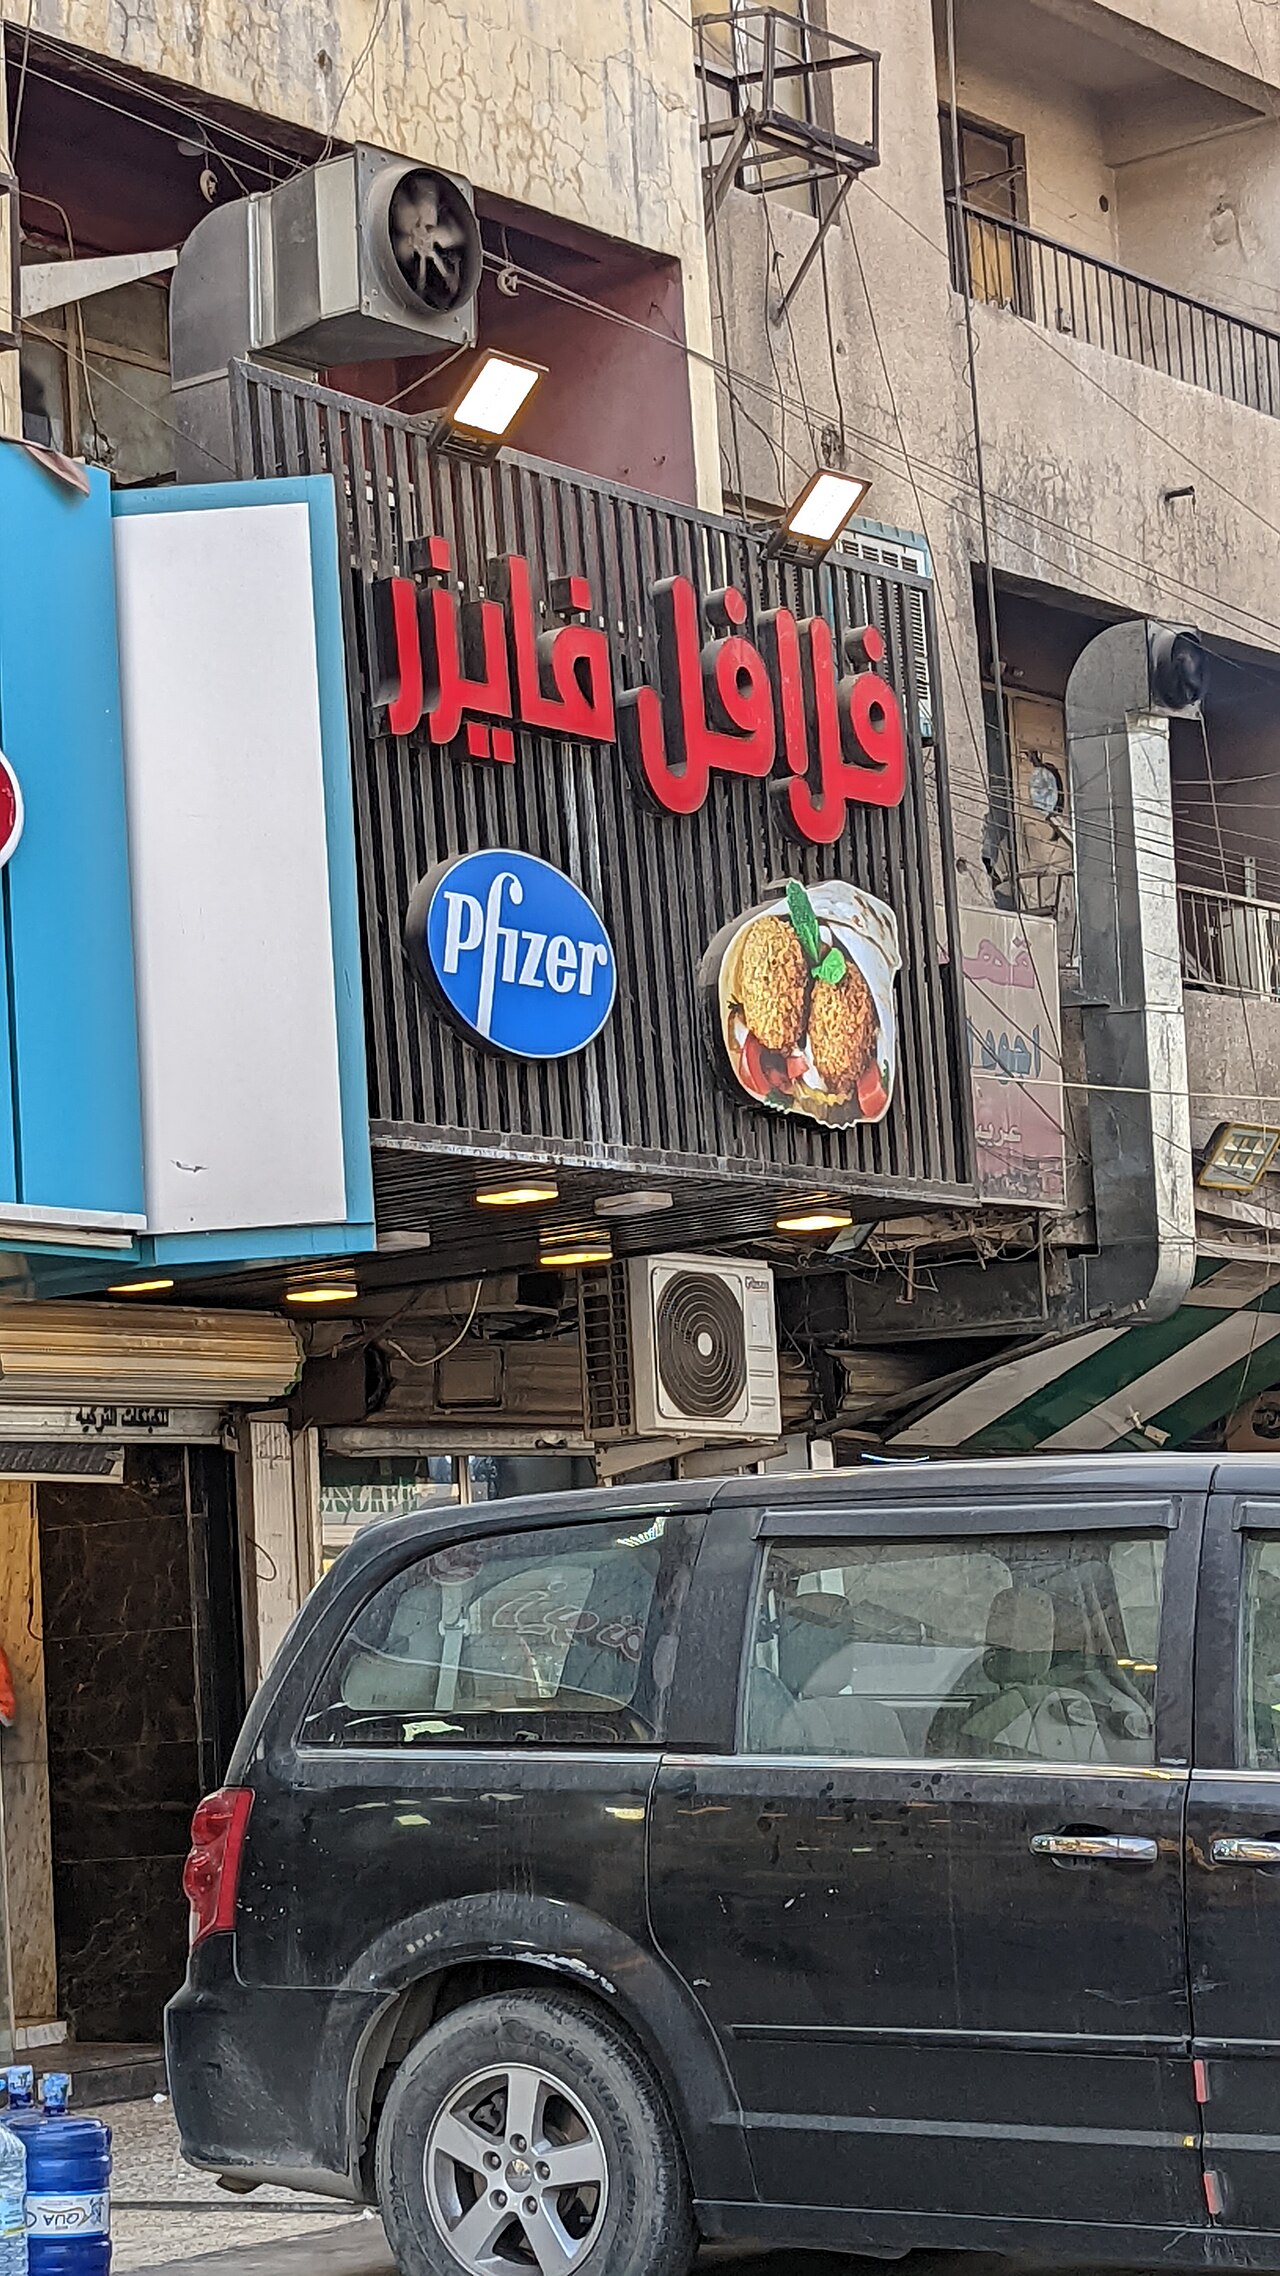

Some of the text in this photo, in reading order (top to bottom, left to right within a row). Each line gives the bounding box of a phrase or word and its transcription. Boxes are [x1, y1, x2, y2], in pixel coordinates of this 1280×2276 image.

[386, 535, 906, 844] فلافل فايزر
[442, 872, 608, 1038] Pfizer
